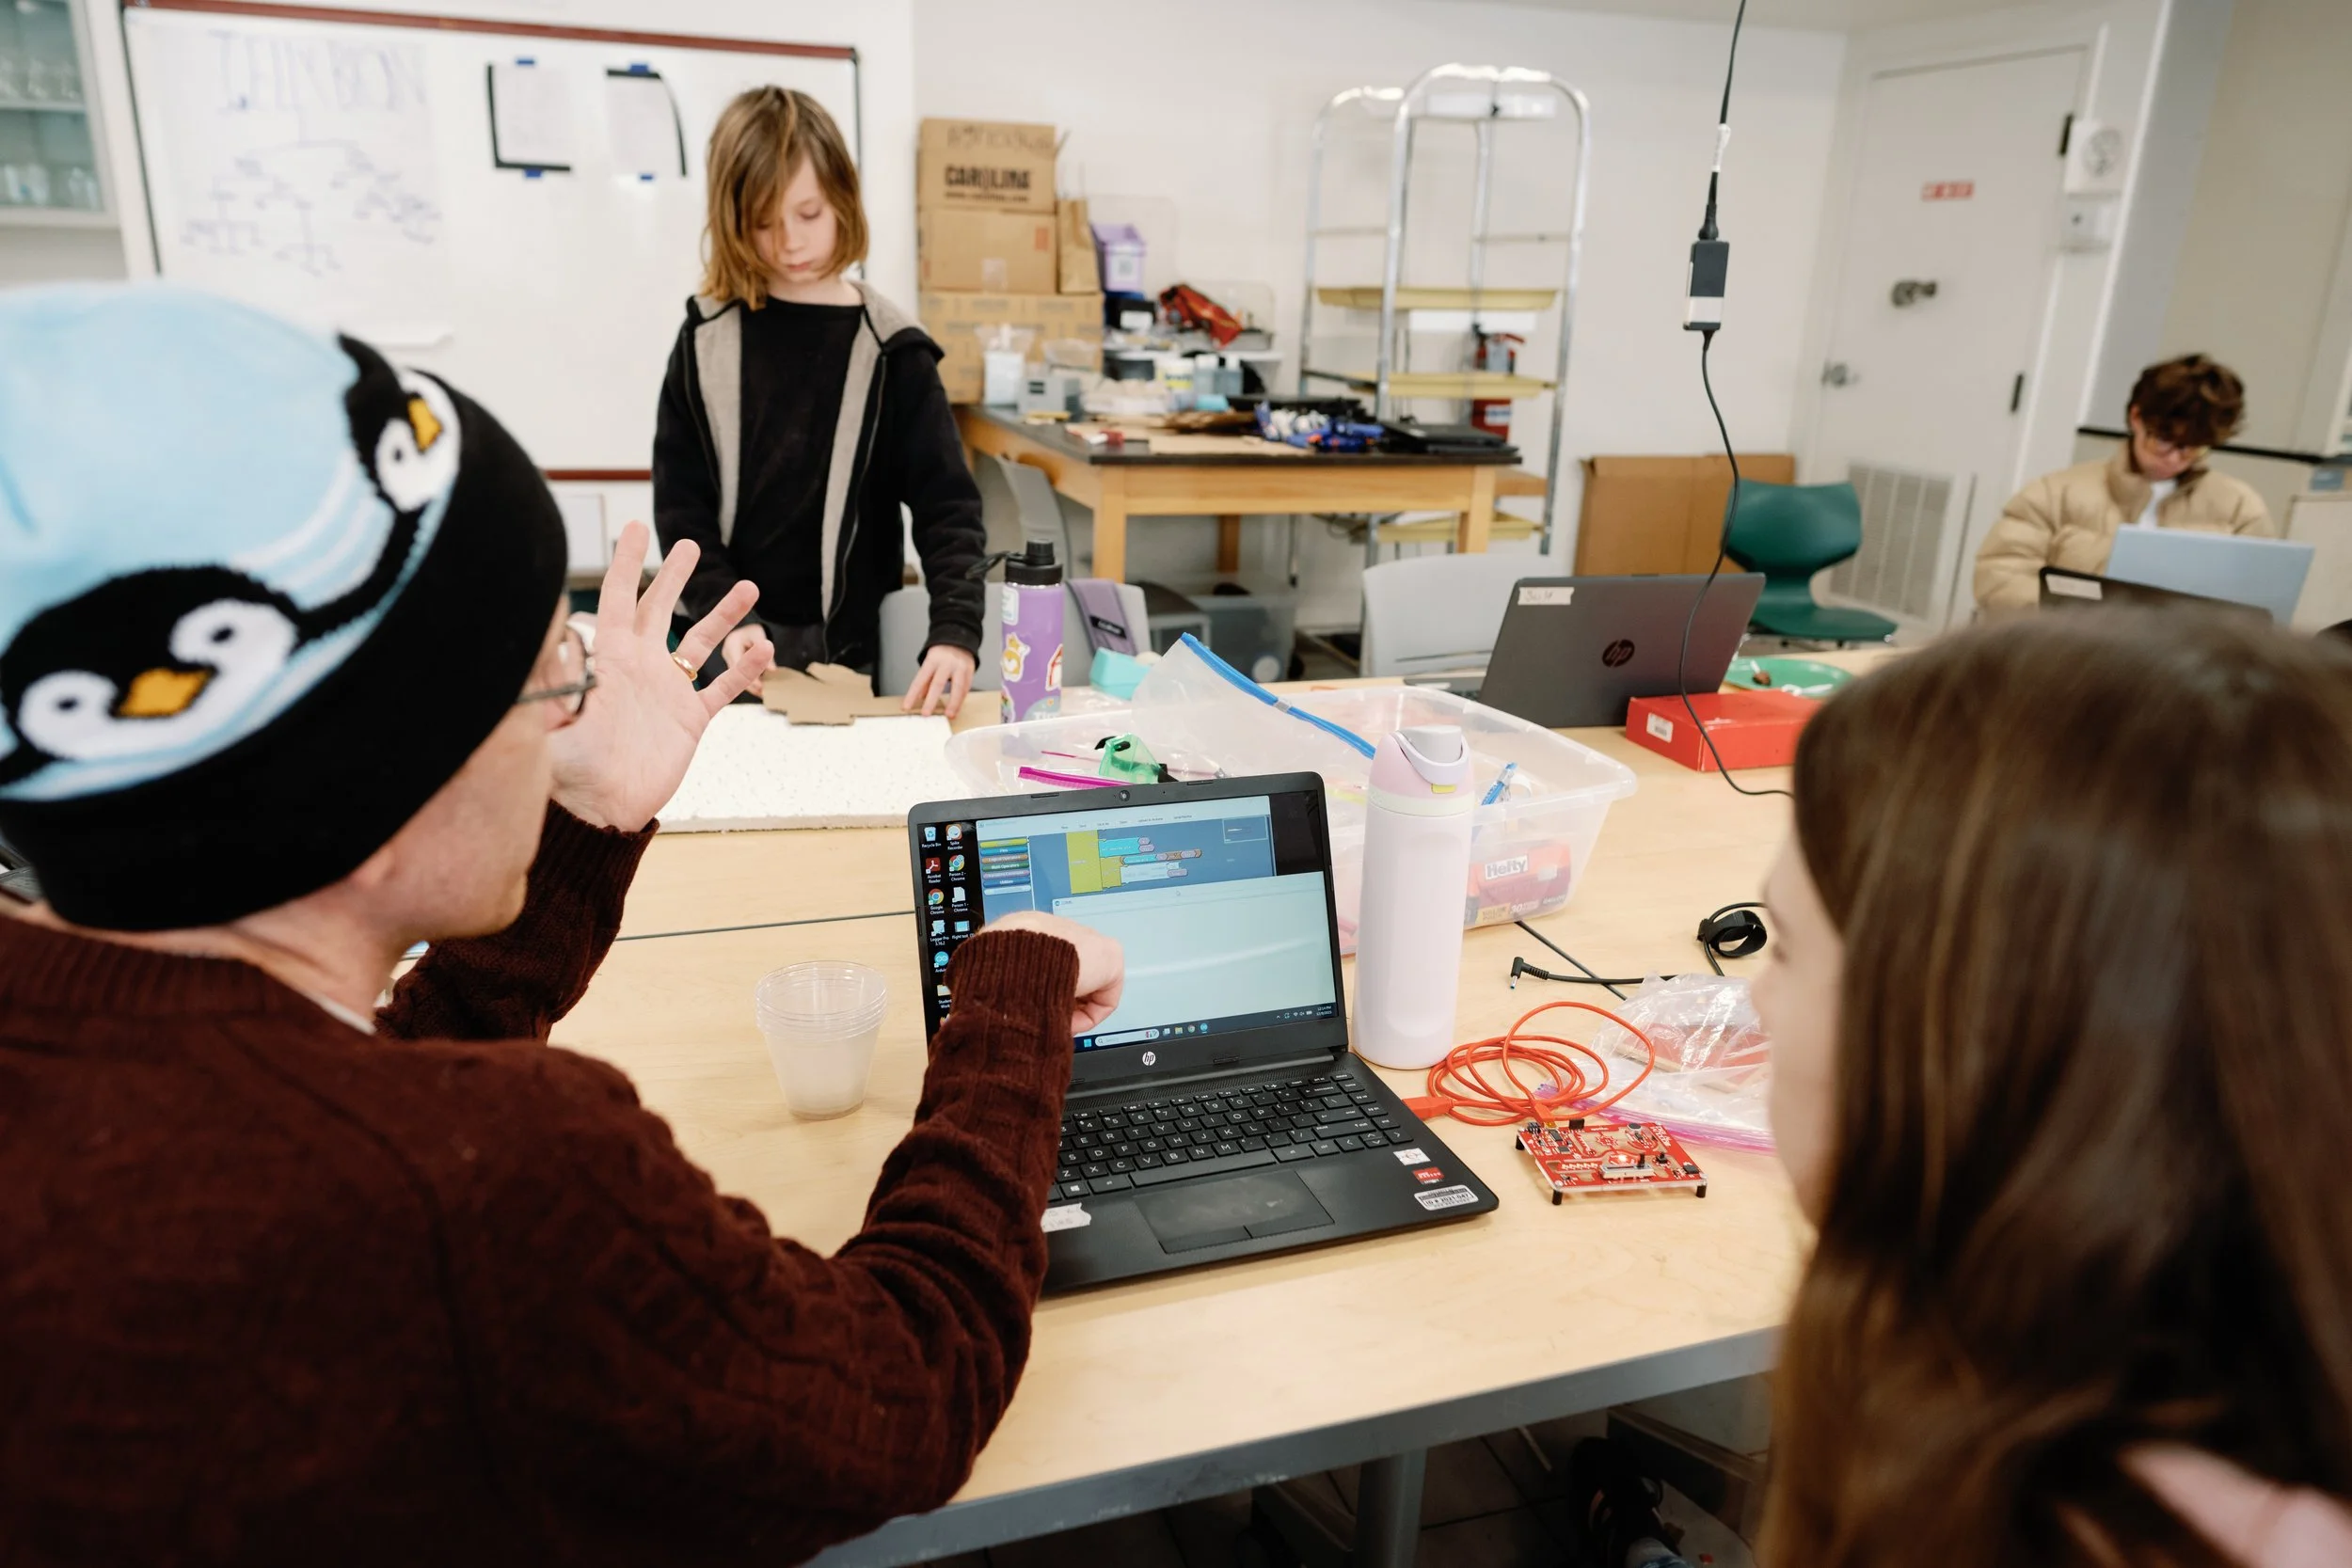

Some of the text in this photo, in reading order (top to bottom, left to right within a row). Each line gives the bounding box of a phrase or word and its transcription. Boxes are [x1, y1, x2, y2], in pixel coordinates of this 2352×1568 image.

[946, 164, 1030, 190] CAROLINA
[1602, 640, 1635, 667] hp
[1486, 860, 1528, 879] Hefty
[1142, 1052, 1156, 1066] hp
